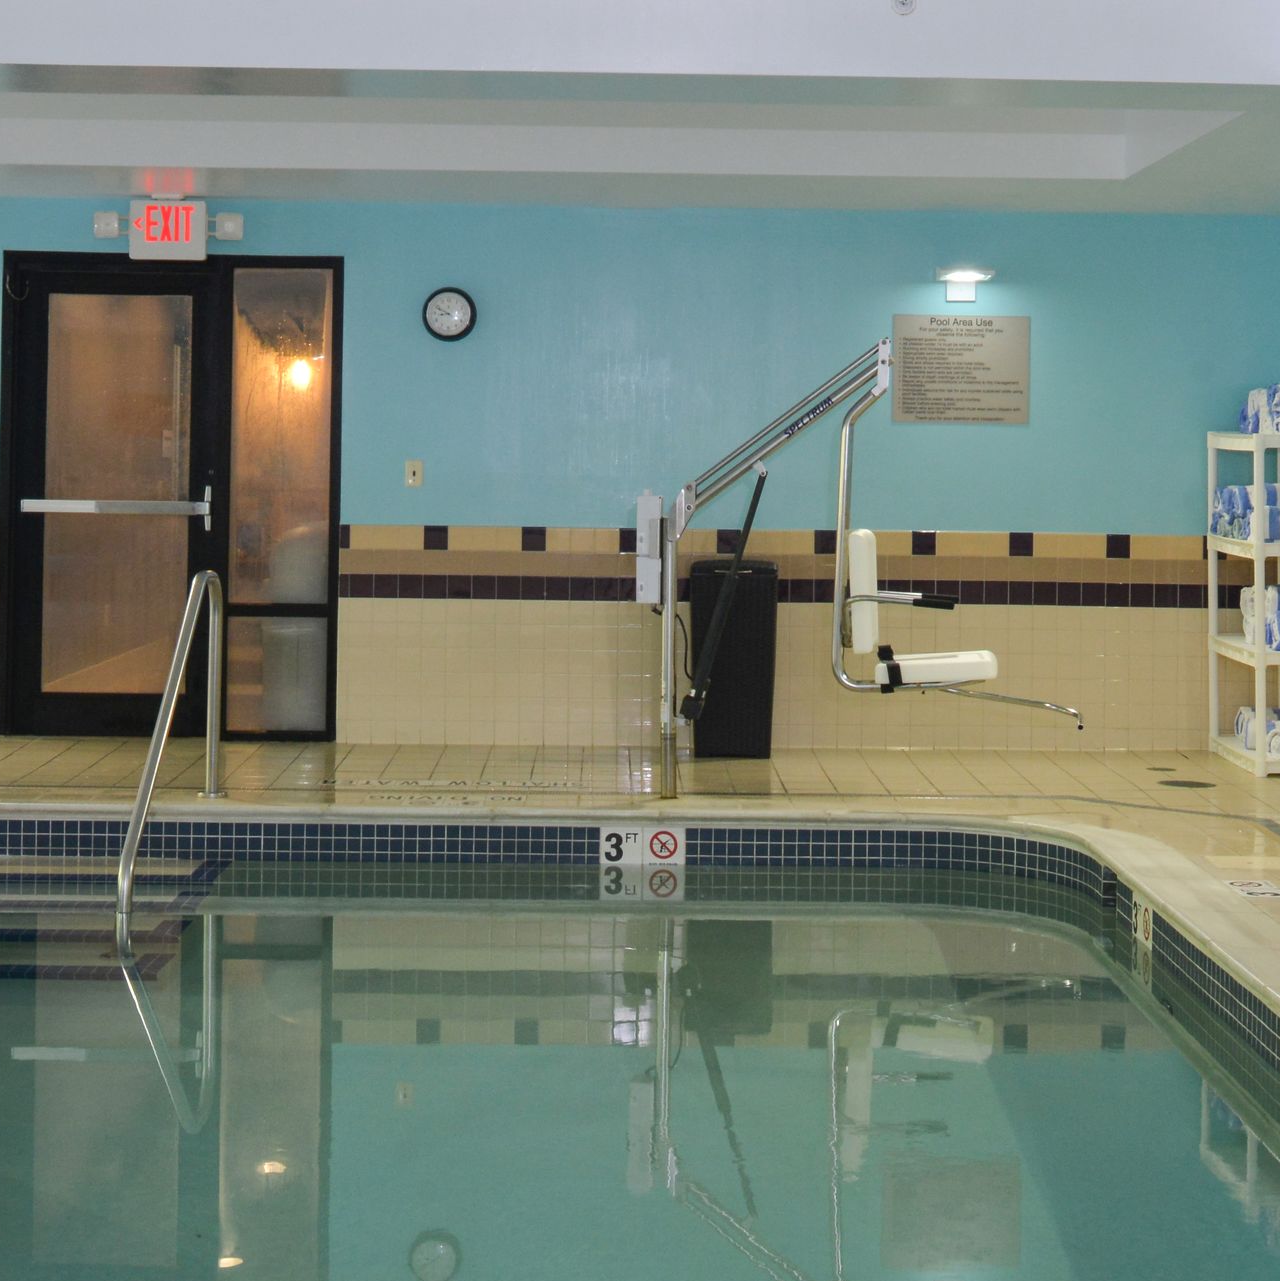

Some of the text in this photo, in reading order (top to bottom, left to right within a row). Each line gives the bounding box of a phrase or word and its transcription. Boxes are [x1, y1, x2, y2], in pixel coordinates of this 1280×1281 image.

[145, 205, 195, 243] EXIT
[930, 317, 994, 327] Pool Area Use
[783, 396, 834, 439] SPECTRUM
[604, 832, 639, 862] 3 FT
[1132, 901, 1139, 935] 3
